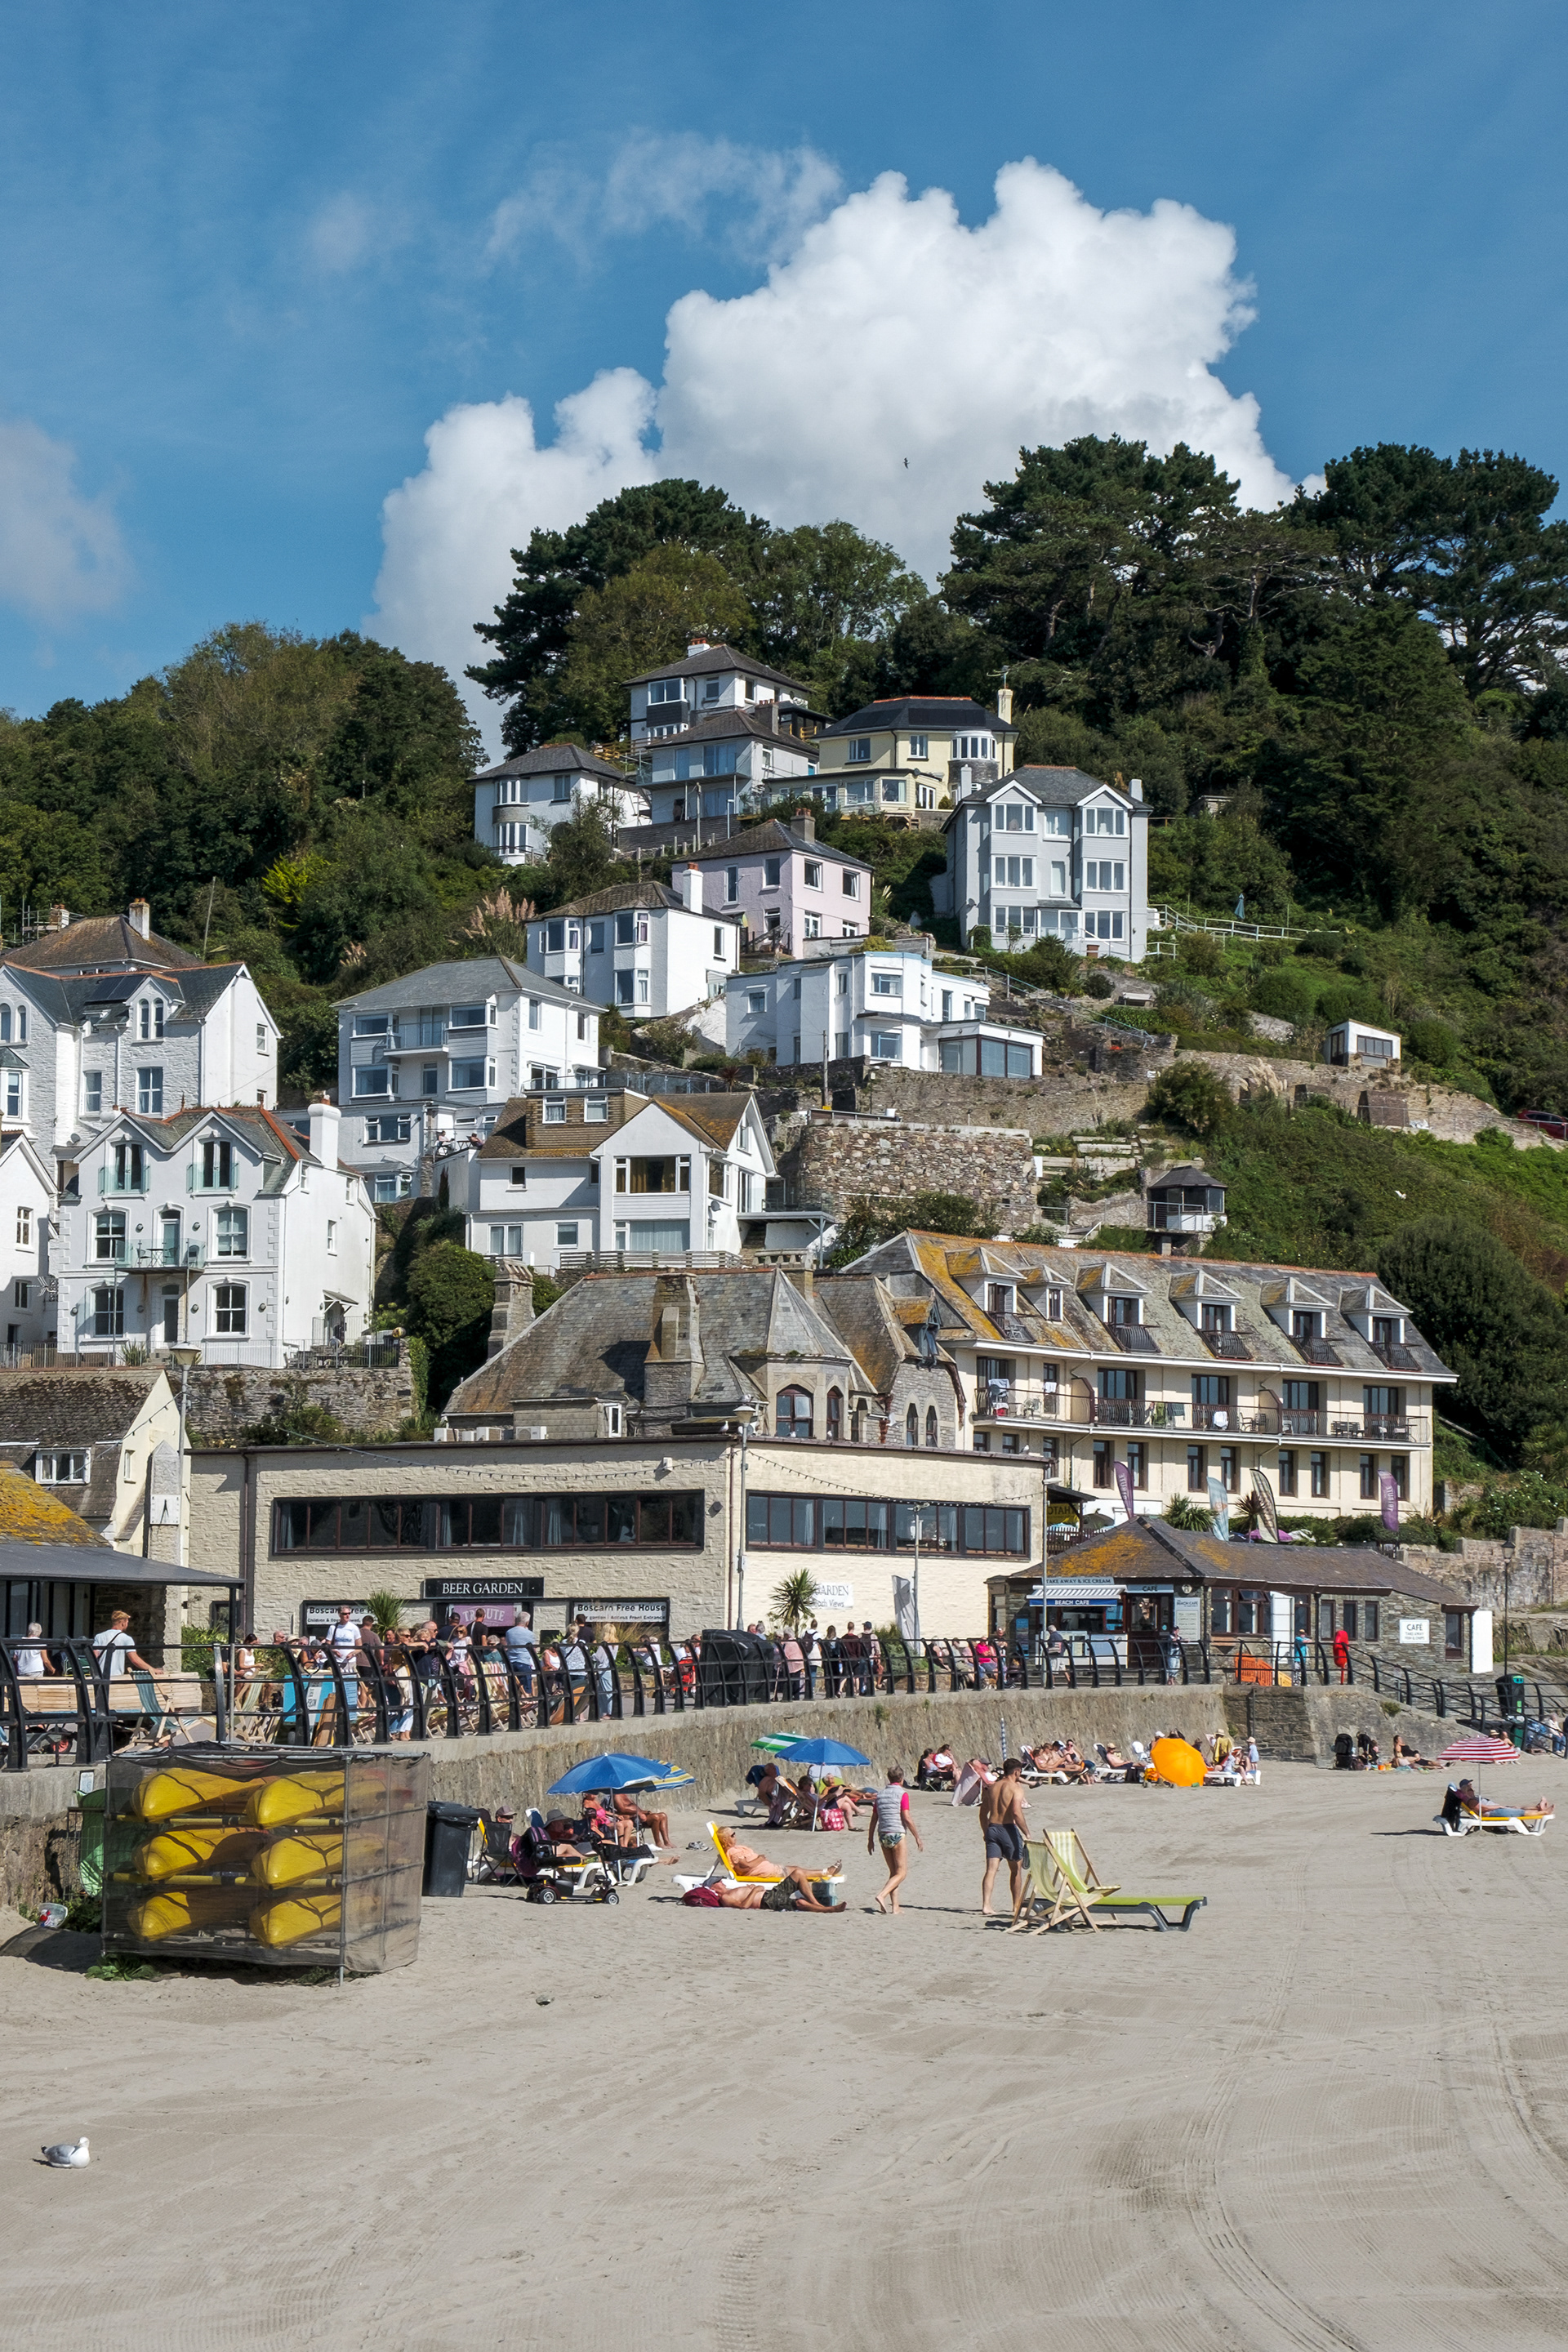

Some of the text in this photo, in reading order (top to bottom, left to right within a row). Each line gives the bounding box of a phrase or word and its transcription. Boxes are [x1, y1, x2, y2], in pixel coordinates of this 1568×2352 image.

[442, 1583, 523, 1594] BEER GARDEN
[577, 1604, 666, 1612] Boscarn Free House
[462, 1608, 506, 1622] TRUTE
